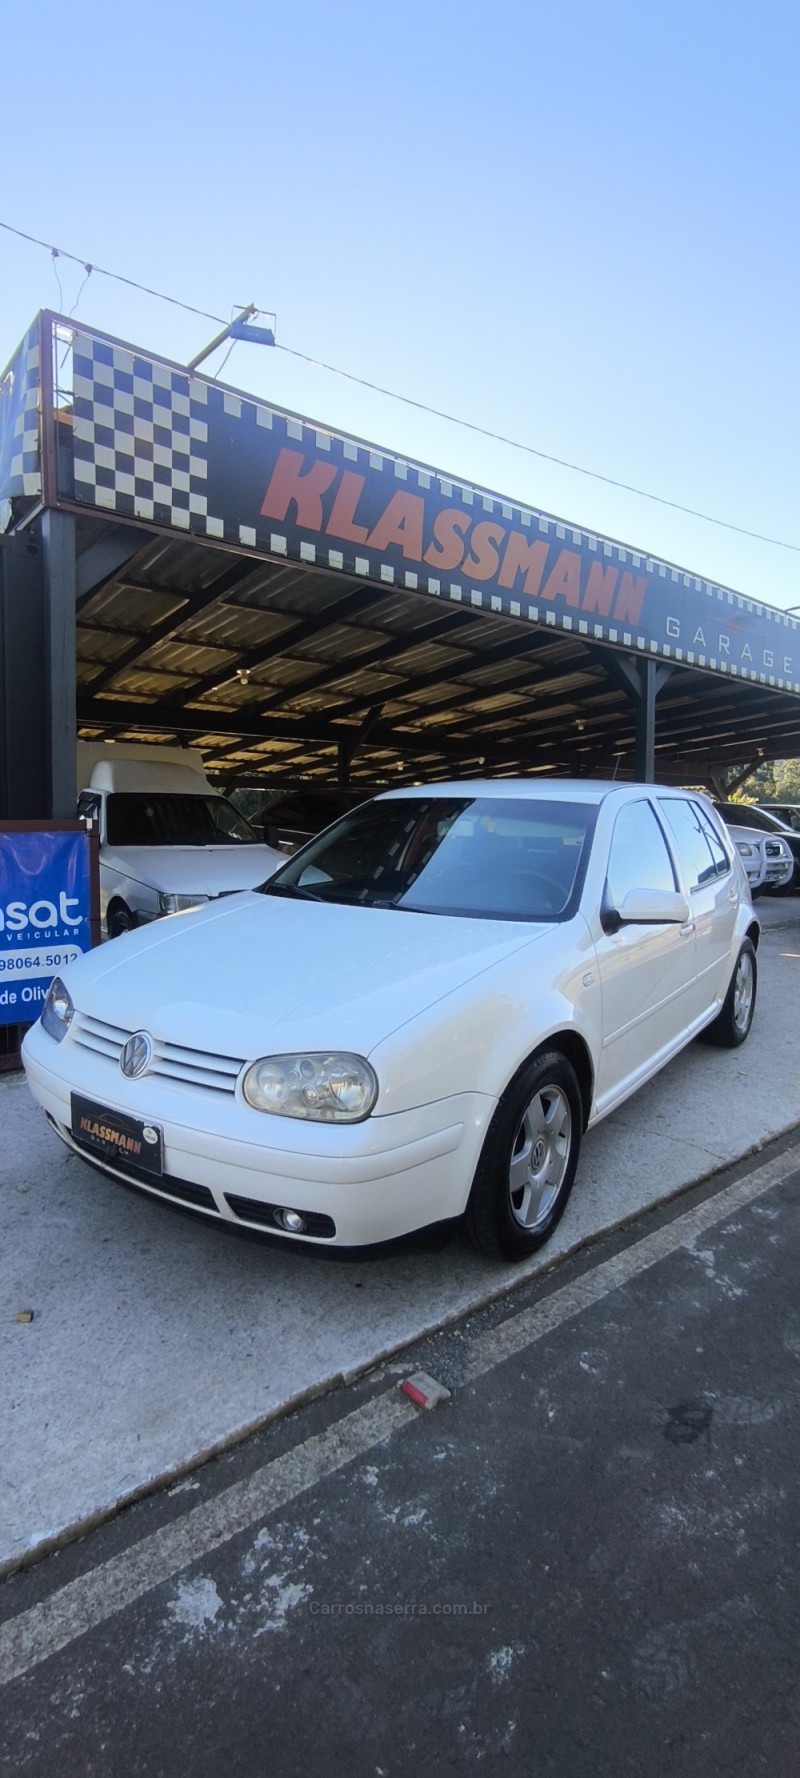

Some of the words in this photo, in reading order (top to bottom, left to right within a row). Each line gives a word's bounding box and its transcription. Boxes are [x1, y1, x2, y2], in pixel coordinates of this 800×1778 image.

[260, 448, 648, 626] KLASSMANN
[666, 616, 793, 674] GARAGE
[6, 928, 79, 942] VEICULAR
[0, 990, 17, 1005] de
[80, 1117, 142, 1155] KLASSMANN
